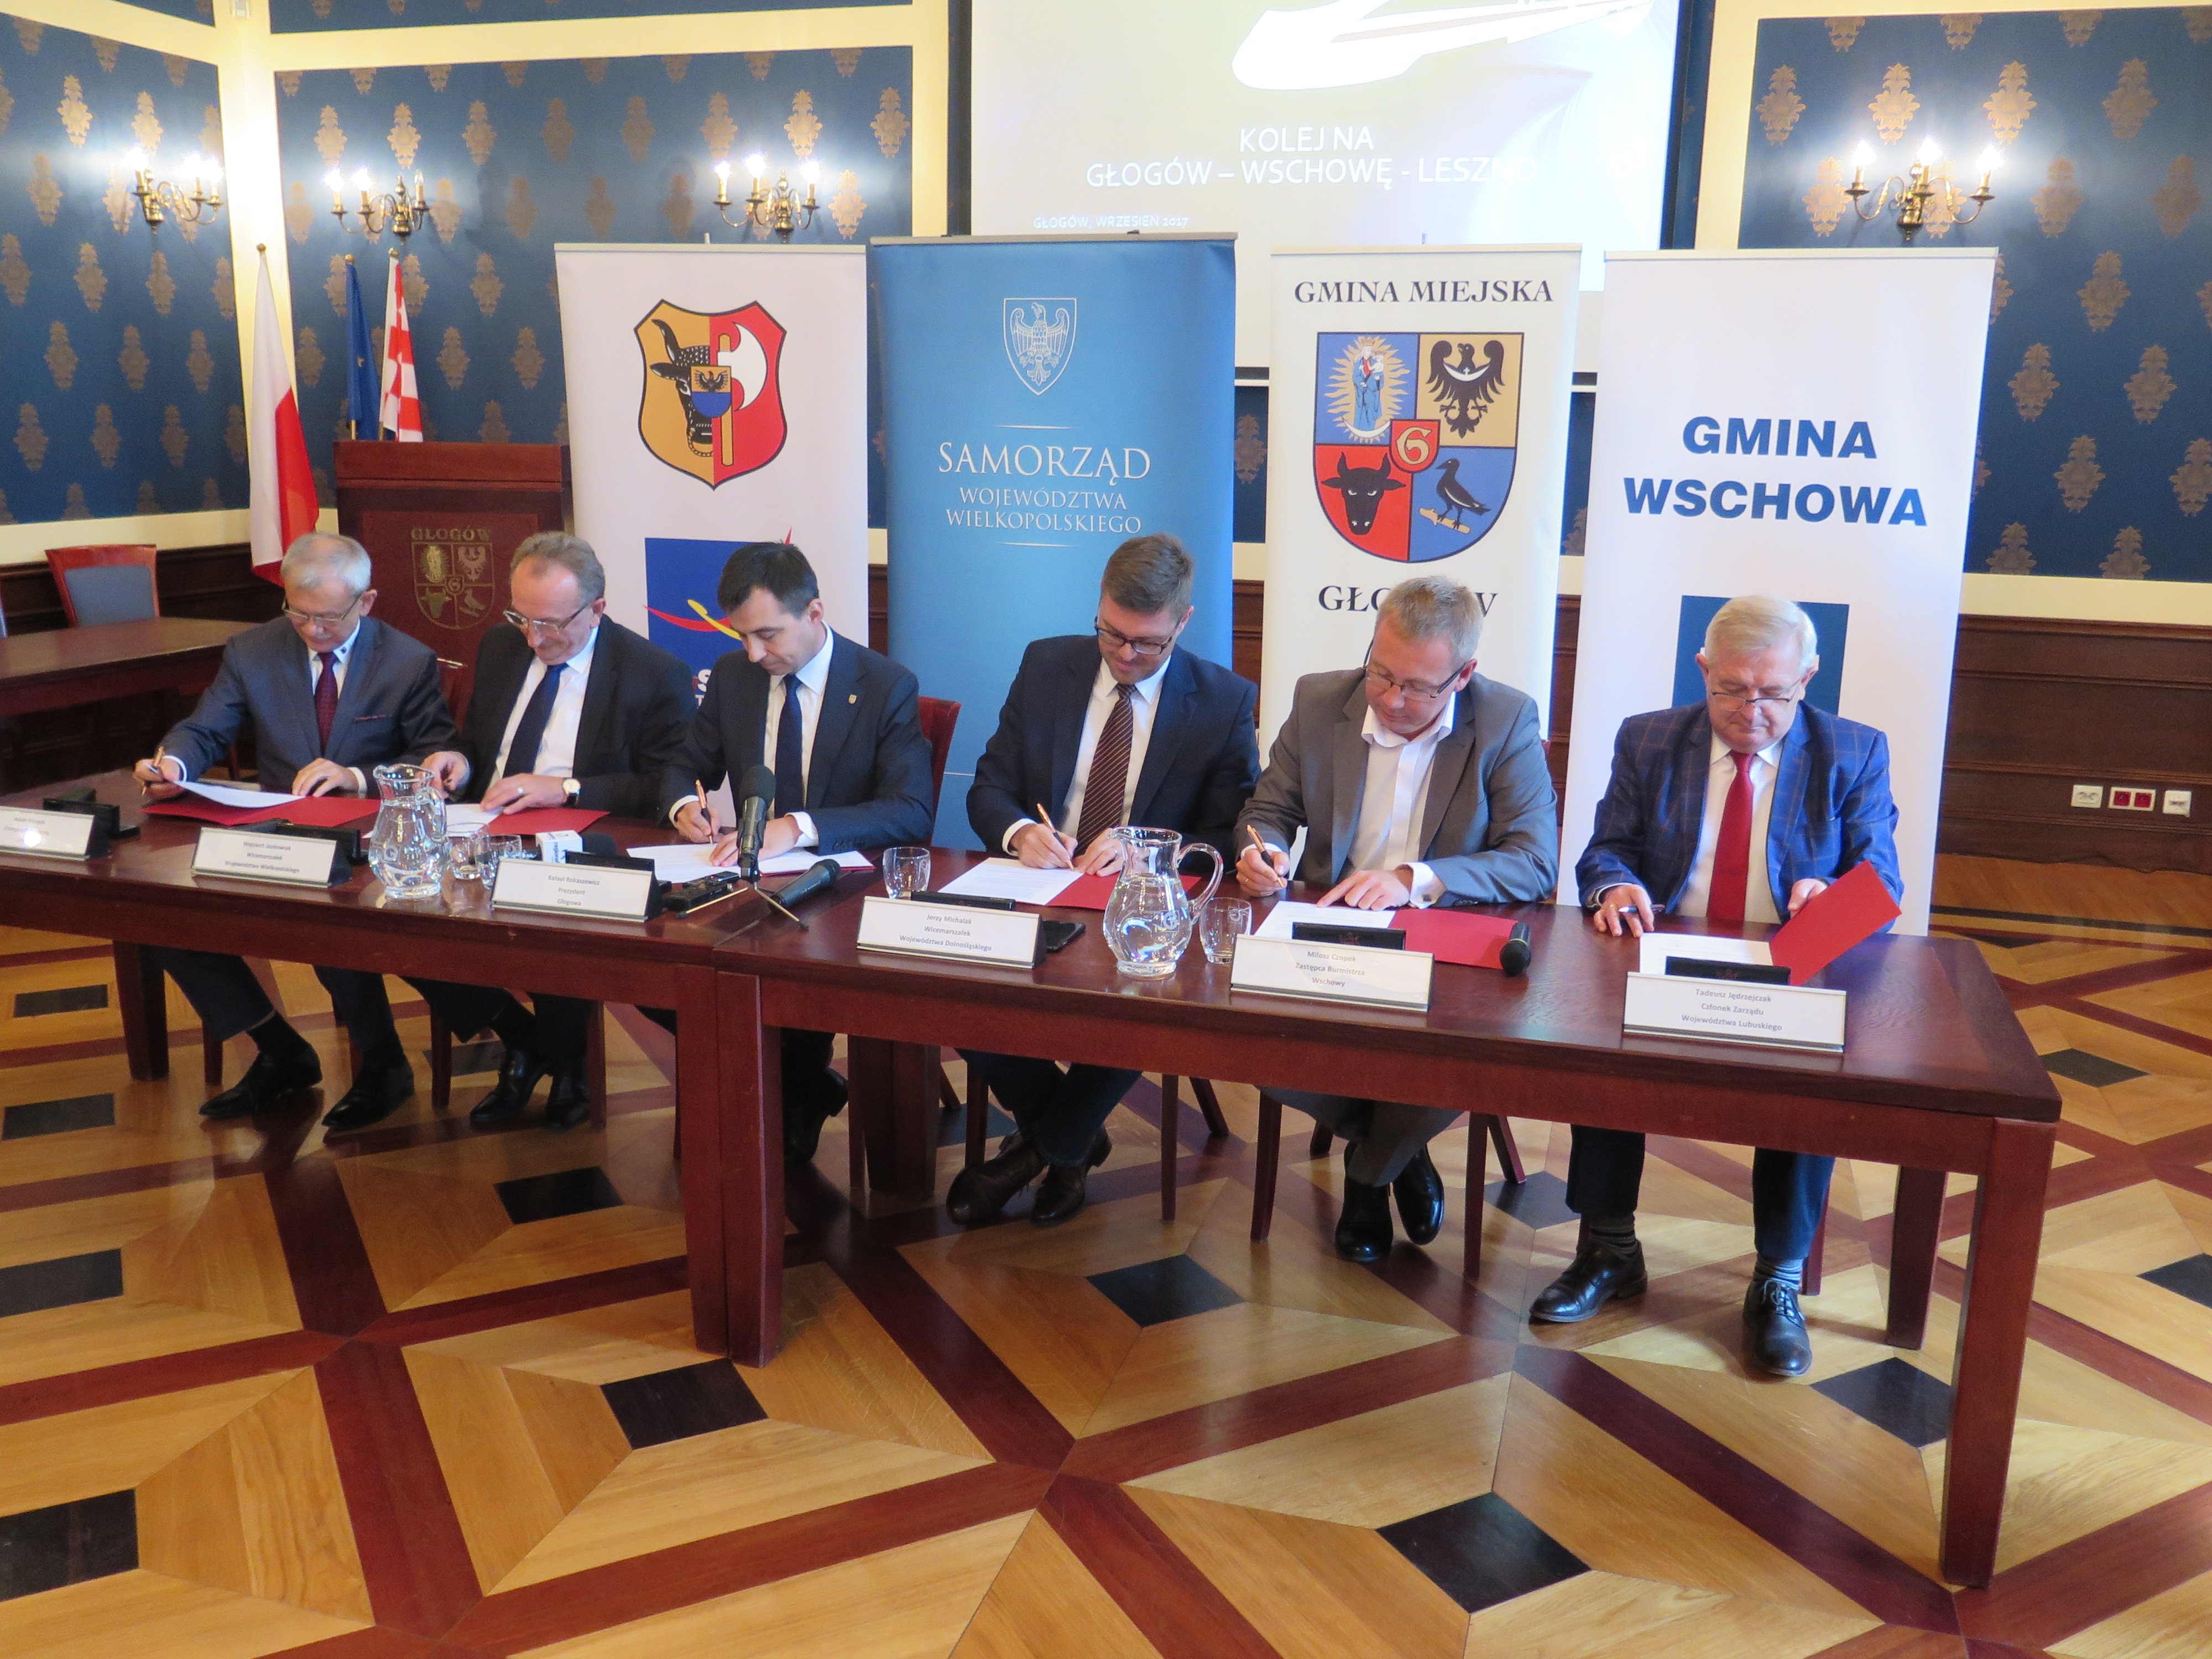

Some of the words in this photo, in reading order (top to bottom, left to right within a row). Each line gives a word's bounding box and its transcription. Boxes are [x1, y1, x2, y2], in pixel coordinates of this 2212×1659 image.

[1240, 127, 1324, 153] KOLEJ
[1333, 126, 1374, 151] NA
[1087, 156, 1212, 187] GŁOGÓW
[1241, 158, 1393, 190] WSCHOWĘ
[1418, 156, 1536, 182] LESZNO
[1033, 215, 1092, 230] GŁOGÓW,
[1096, 213, 1159, 228] WRZESIEŃ
[1162, 217, 1188, 228] 2017
[1295, 281, 1400, 303] GMINA
[1407, 280, 1554, 302] MIEJSKA
[1682, 416, 1877, 459] GMINA
[938, 442, 1151, 486] SAMORZĄD
[959, 487, 1128, 510] WOJEWÓDZTWA
[1624, 477, 1927, 526] WSCHOWA
[946, 509, 1141, 534] WIELKOPOLSKIEGO
[557, 887, 586, 895] Prezydent
[926, 914, 942, 922] Jerzy
[943, 916, 972, 925] Michalak
[924, 925, 971, 936] Wicemarszałek
[899, 935, 943, 945] Województwa
[945, 940, 992, 952] Dolnośląskiego
[1307, 951, 1329, 959] Miłosz
[1331, 954, 1357, 962] Czopek
[1295, 962, 1326, 972] Zastępca
[1327, 966, 1365, 976] Burmistrza
[1312, 977, 1346, 988] Wschowy
[1695, 989, 1726, 998] Tadeusz
[1728, 992, 1772, 1002] Jędrzejczak
[1701, 1003, 1731, 1012] Członek
[1733, 1006, 1764, 1016] Zarządu
[1681, 1014, 1736, 1026] Województwa
[1738, 1020, 1782, 1032] Lubuskiego
